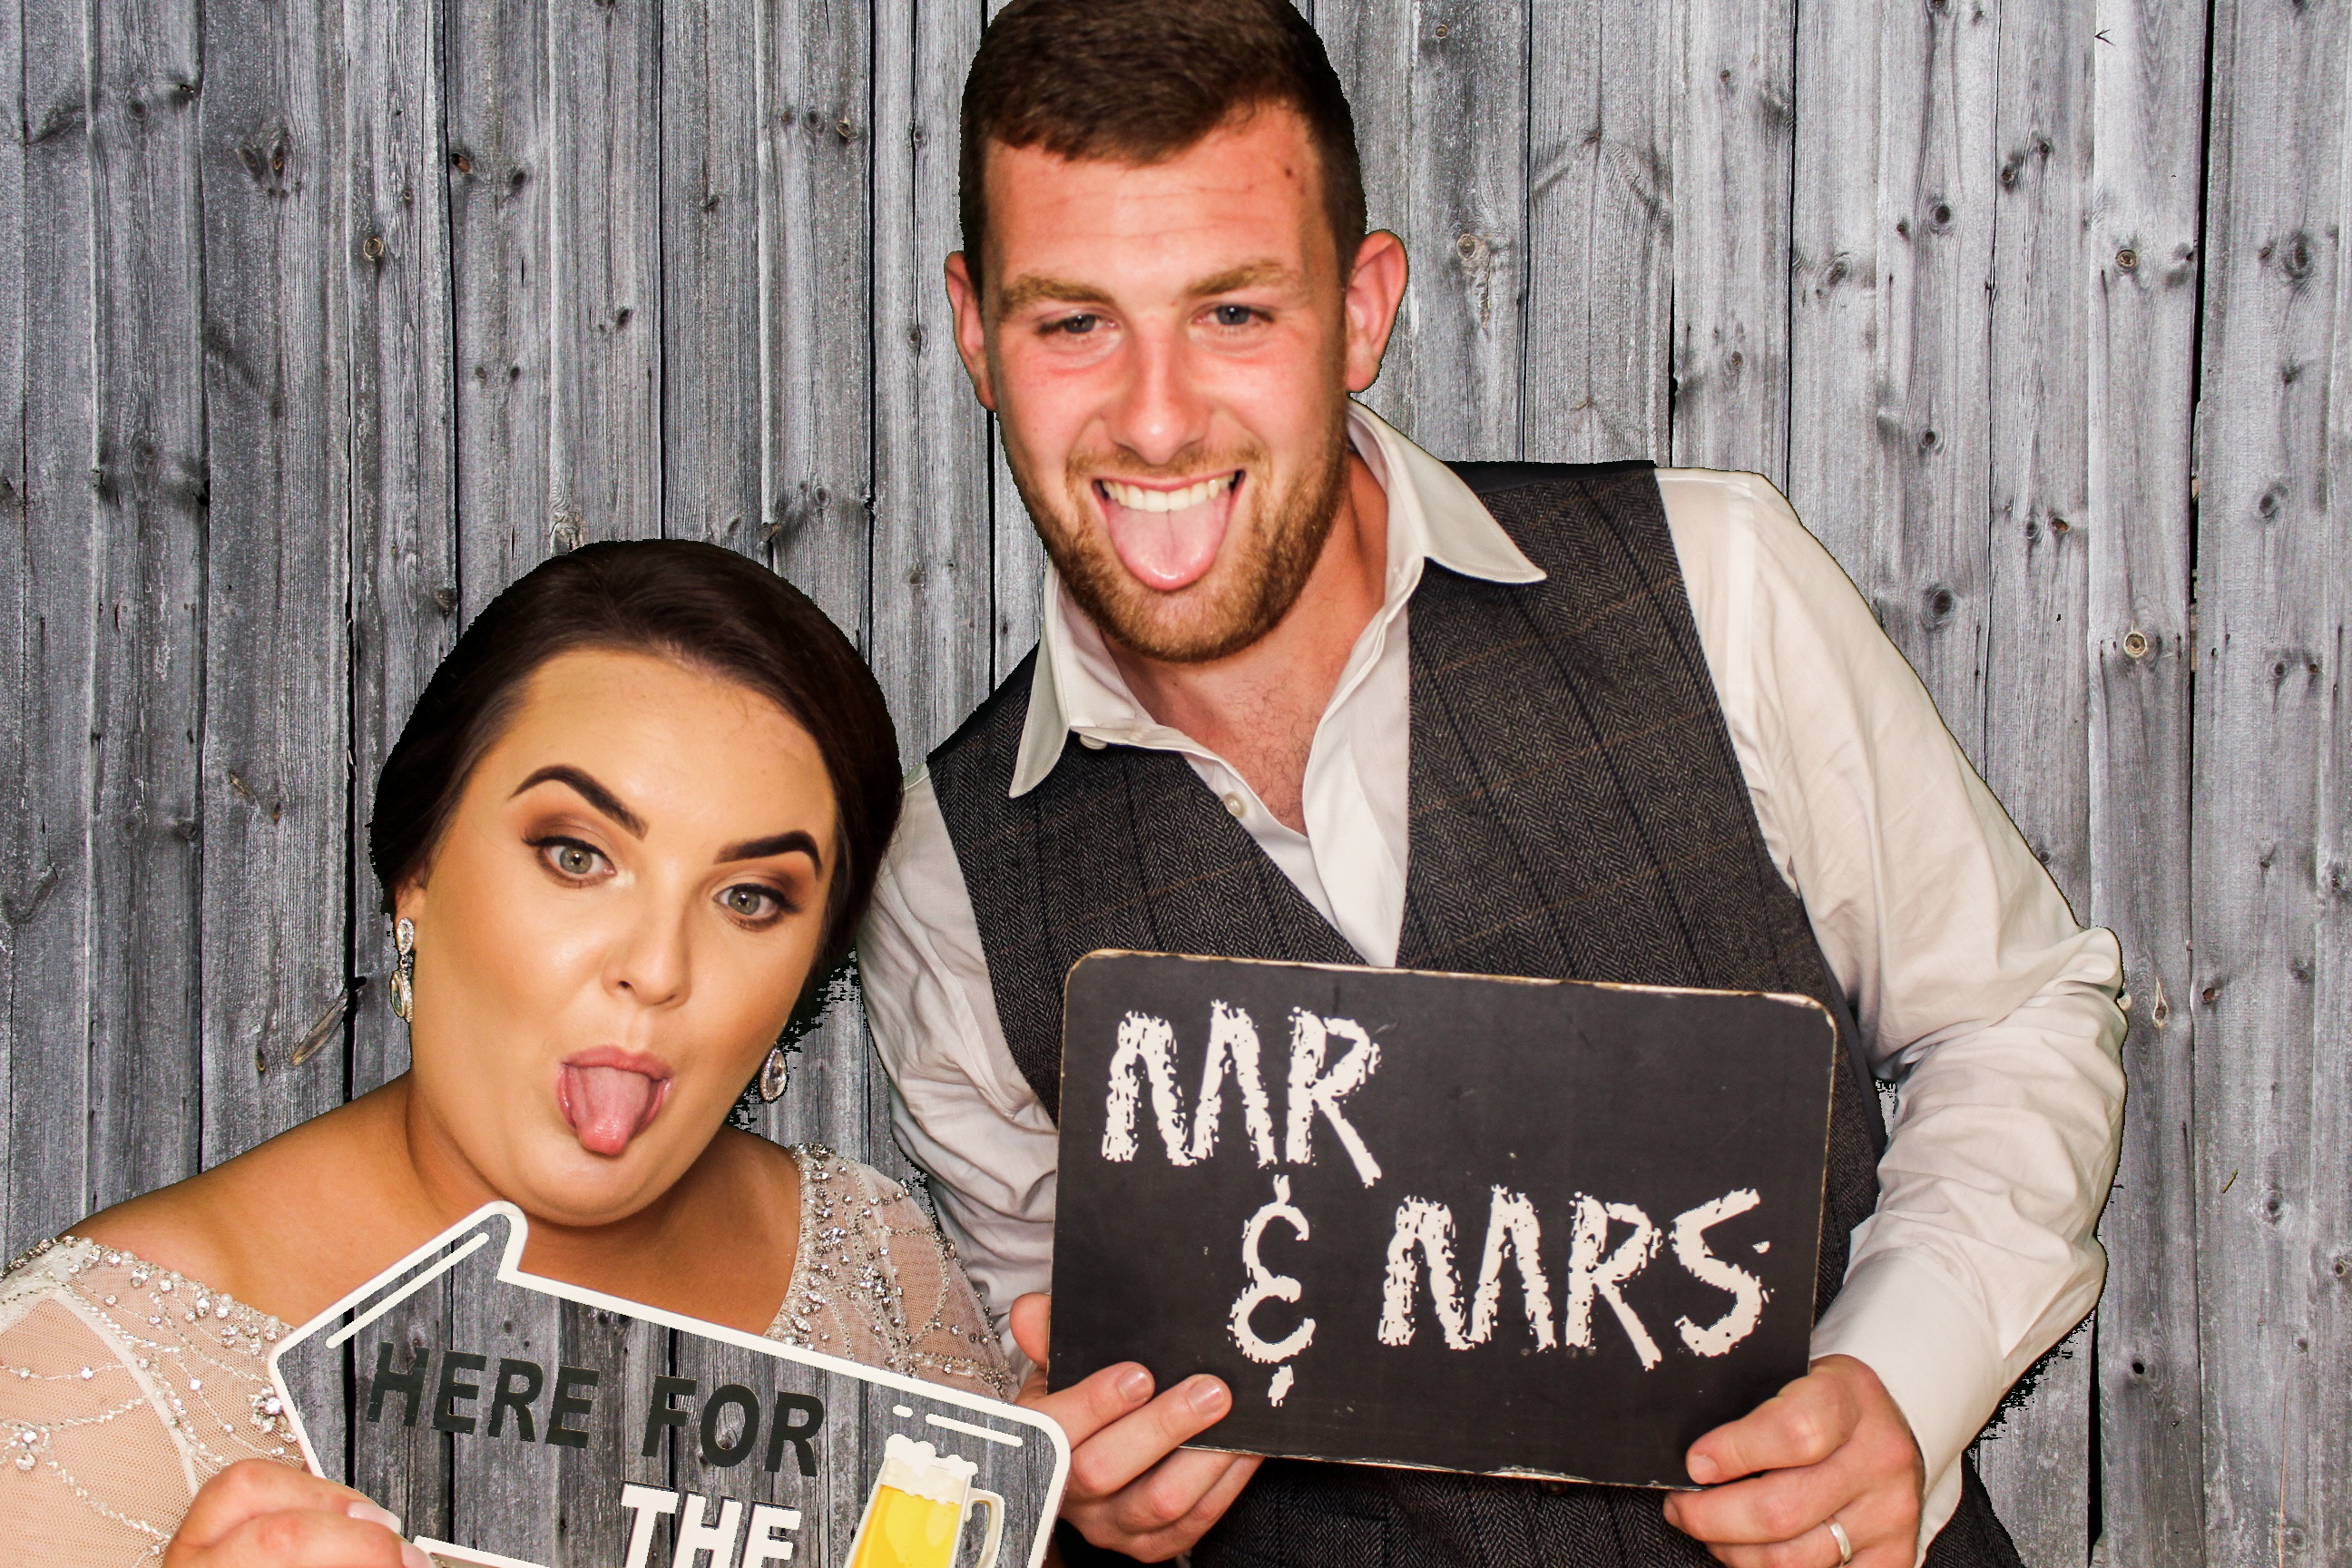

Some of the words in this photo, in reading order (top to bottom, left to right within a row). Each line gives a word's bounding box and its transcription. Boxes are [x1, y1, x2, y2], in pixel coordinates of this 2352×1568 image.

[1102, 999, 1382, 1188] MR
[1227, 1174, 1316, 1407] &
[1377, 1184, 1775, 1371] MRS
[368, 1342, 601, 1448] HERE
[642, 1375, 824, 1476] FOR
